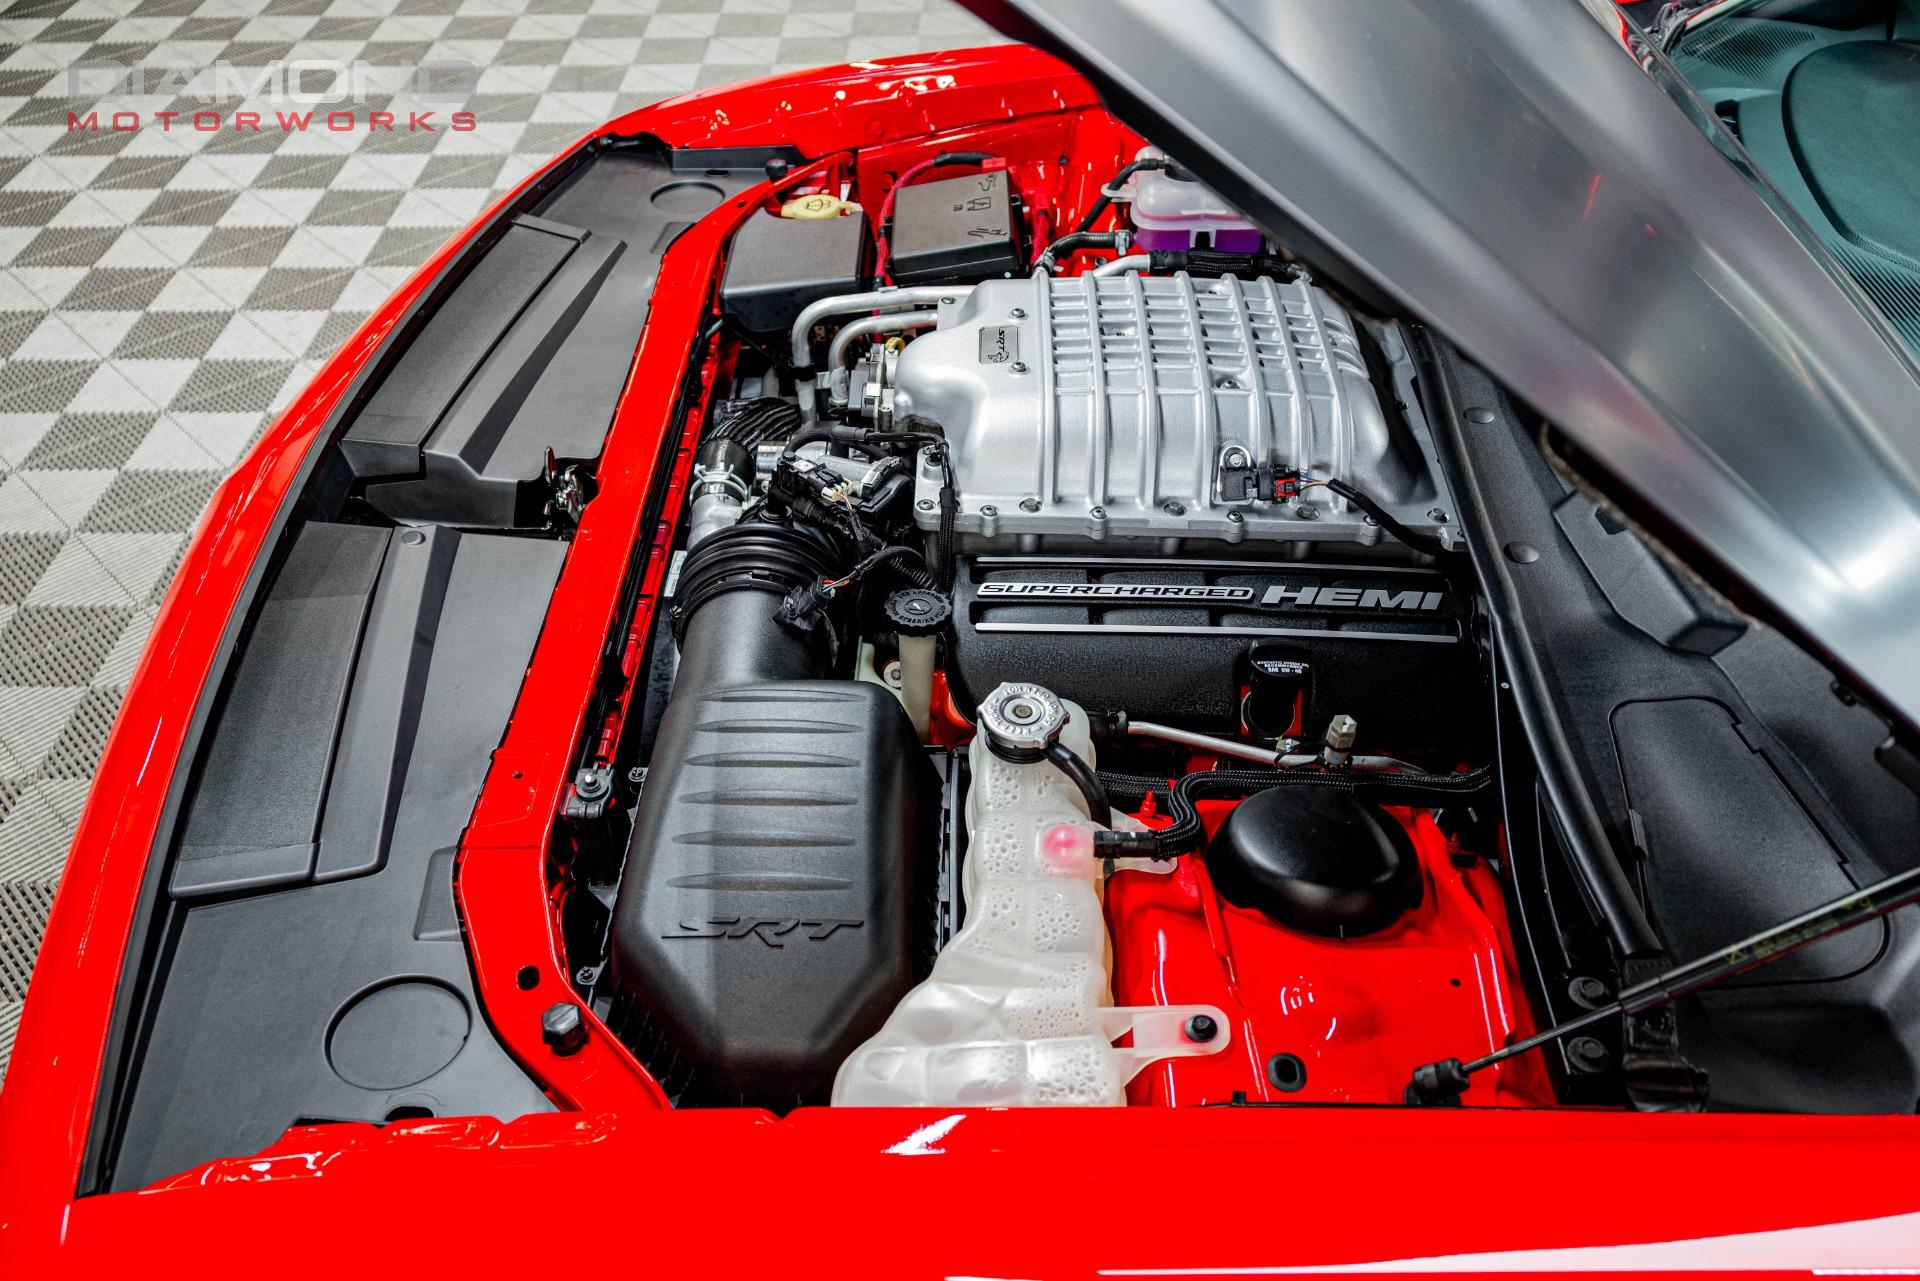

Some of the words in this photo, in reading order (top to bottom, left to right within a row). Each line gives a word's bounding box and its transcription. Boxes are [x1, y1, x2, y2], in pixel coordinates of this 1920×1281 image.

[980, 584, 1251, 598] SUPERCHARGED
[1261, 585, 1443, 610] HEMI
[661, 916, 865, 949] SRT
